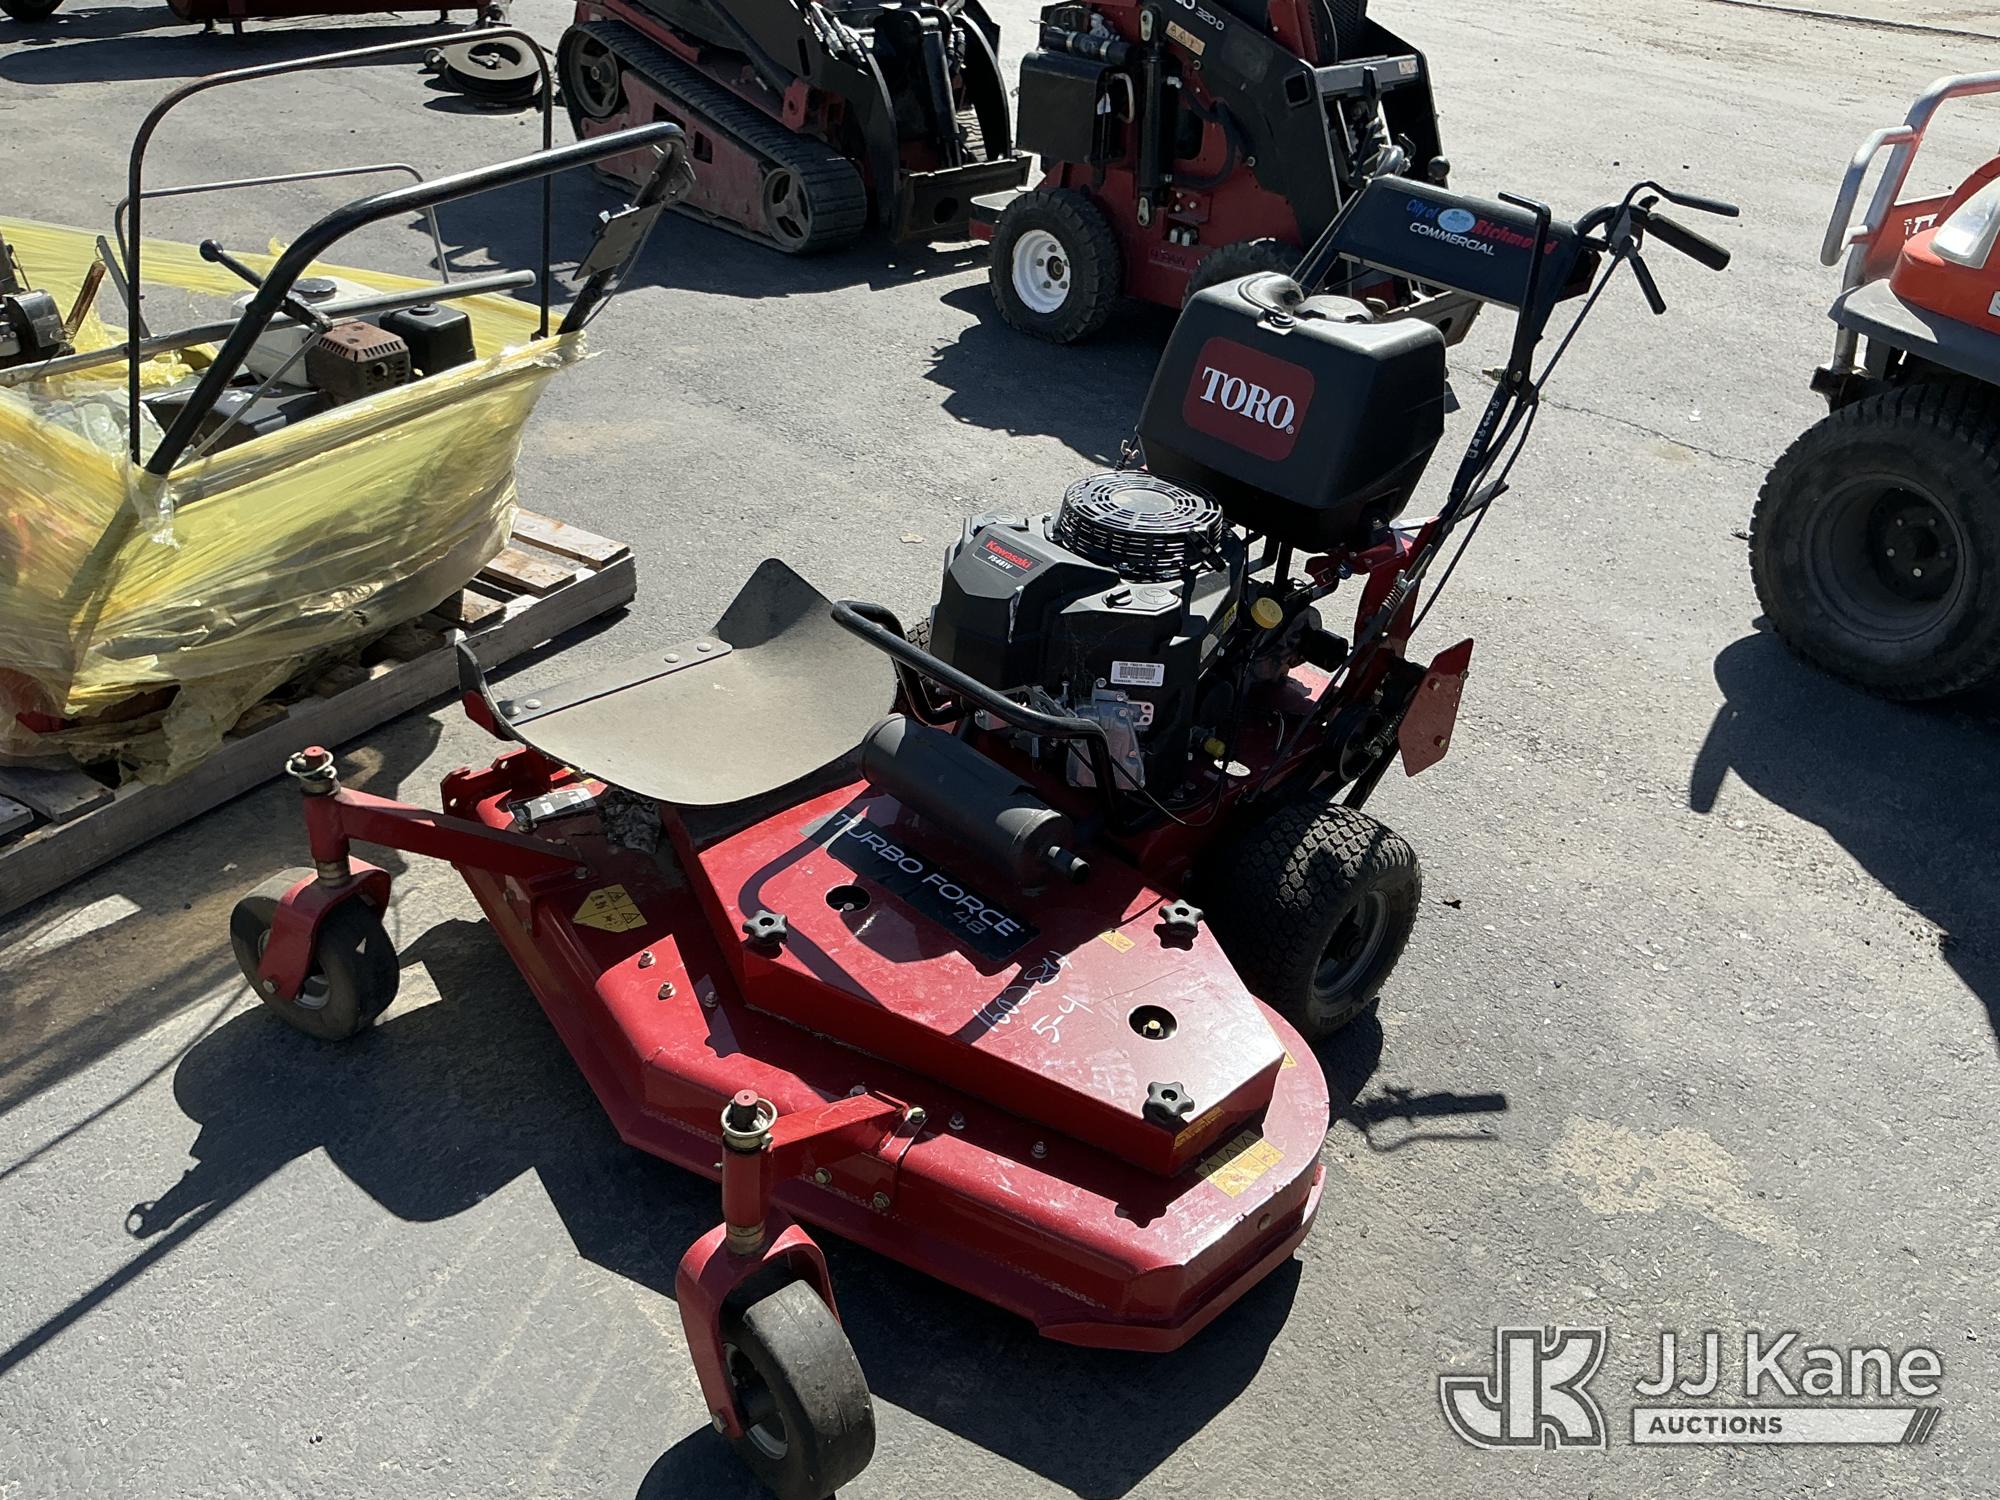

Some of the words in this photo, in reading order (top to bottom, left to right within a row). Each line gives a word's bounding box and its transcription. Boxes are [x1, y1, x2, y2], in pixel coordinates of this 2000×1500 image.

[1406, 199, 1424, 218] City
[1425, 207, 1440, 219] of
[1472, 219, 1559, 255] Richmod
[1409, 222, 1495, 256] COMMERCIAL
[1200, 366, 1295, 430] TORO
[986, 540, 1033, 569] Kawasaki
[834, 813, 924, 874] TURBO
[921, 873, 1021, 937] FORCE
[953, 911, 988, 935] 48
